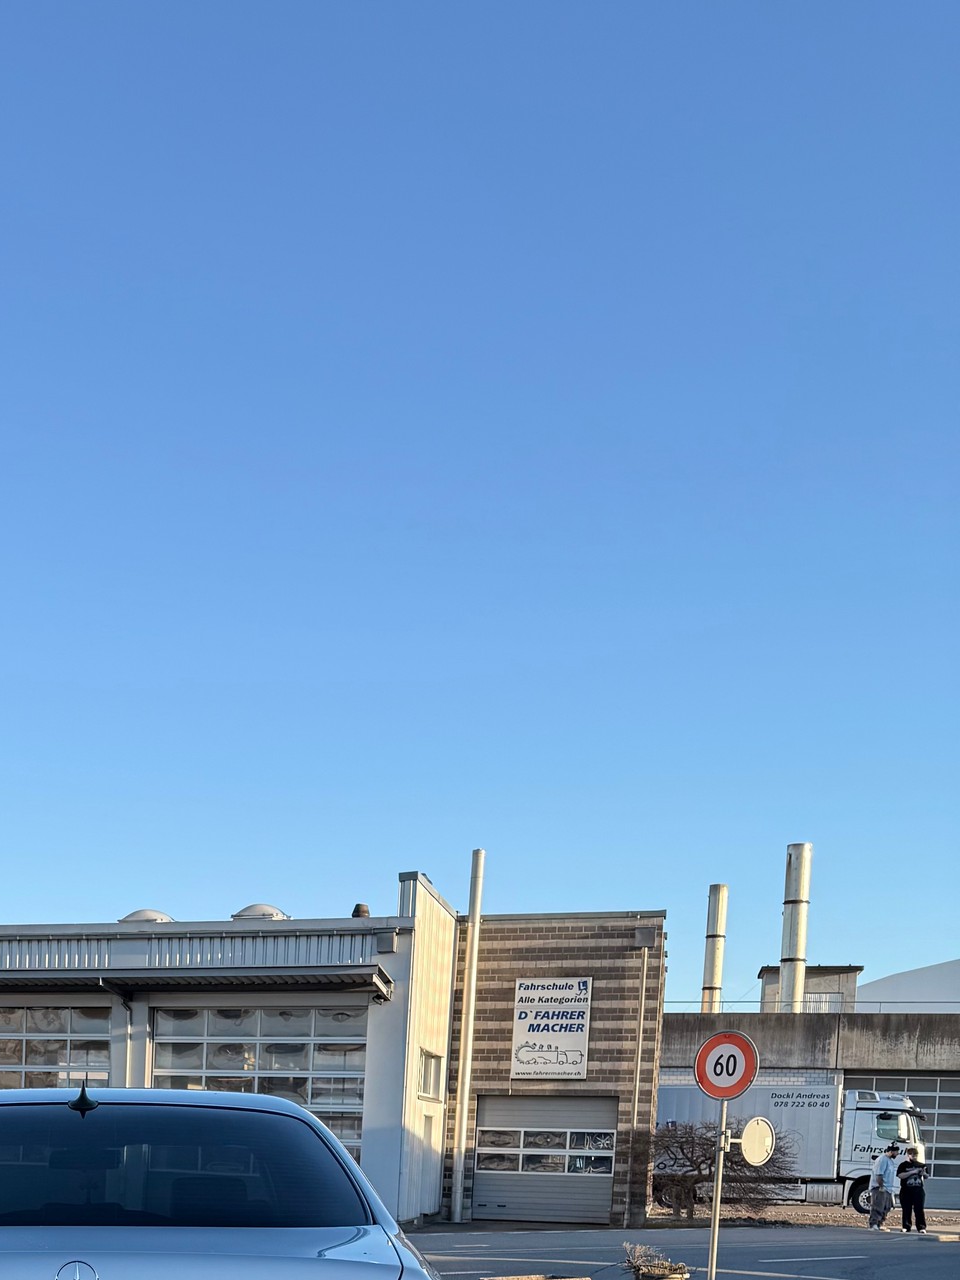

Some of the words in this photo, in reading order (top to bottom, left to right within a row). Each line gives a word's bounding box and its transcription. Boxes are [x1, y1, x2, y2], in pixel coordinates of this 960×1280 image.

[518, 983, 574, 991] Fahrschule
[537, 996, 588, 1004] Kategorien
[527, 1023, 585, 1033] MACHER
[713, 1054, 737, 1077] 60
